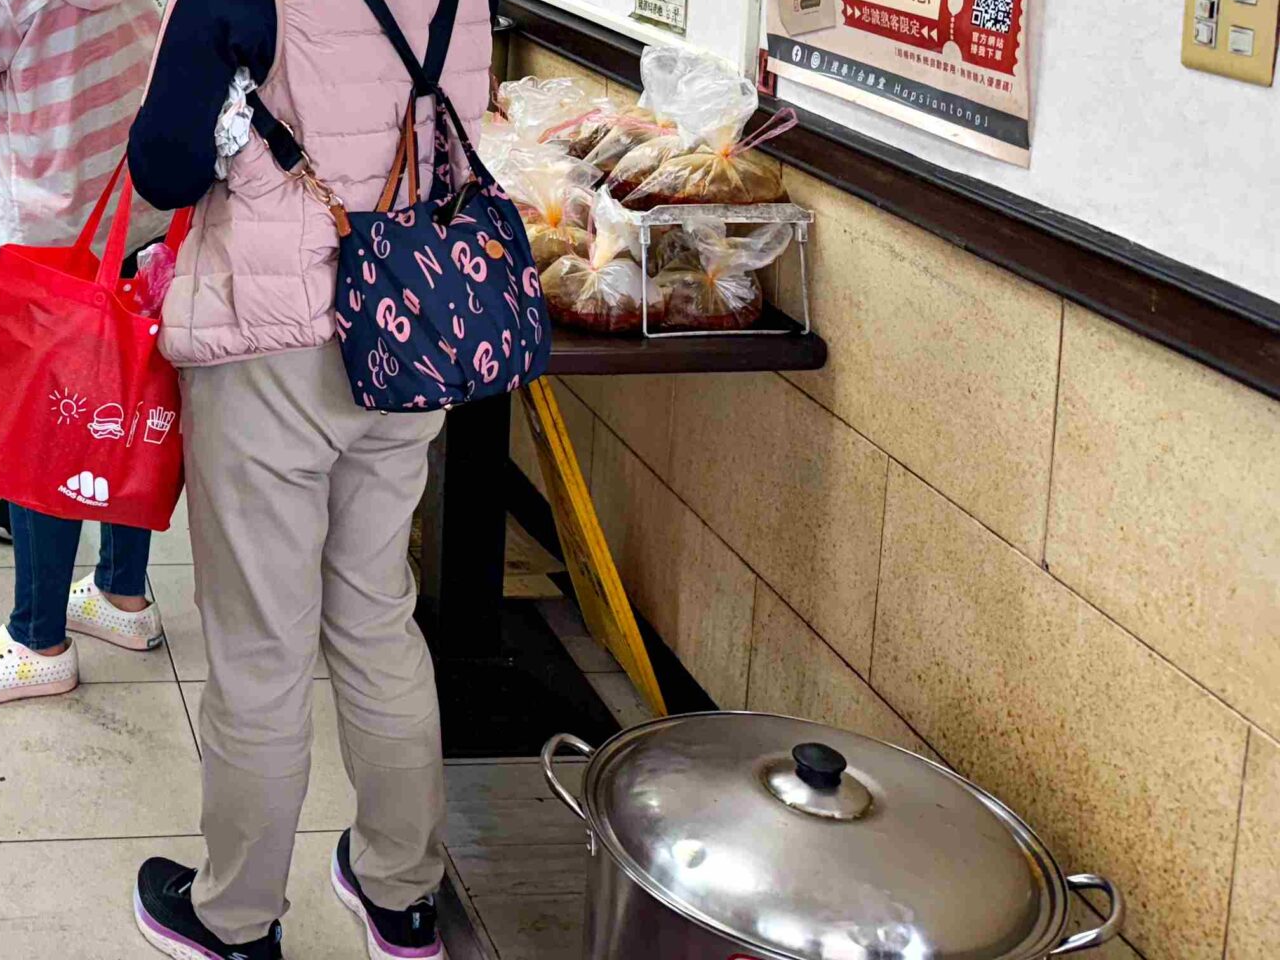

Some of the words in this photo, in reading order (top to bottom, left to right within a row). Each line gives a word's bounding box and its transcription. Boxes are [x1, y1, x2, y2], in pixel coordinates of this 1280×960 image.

[862, 6, 920, 38] 忠誠熟客限定
[972, 32, 1004, 49] 官方網站
[57, 485, 77, 500] MOS
[76, 495, 109, 508] BURGER
